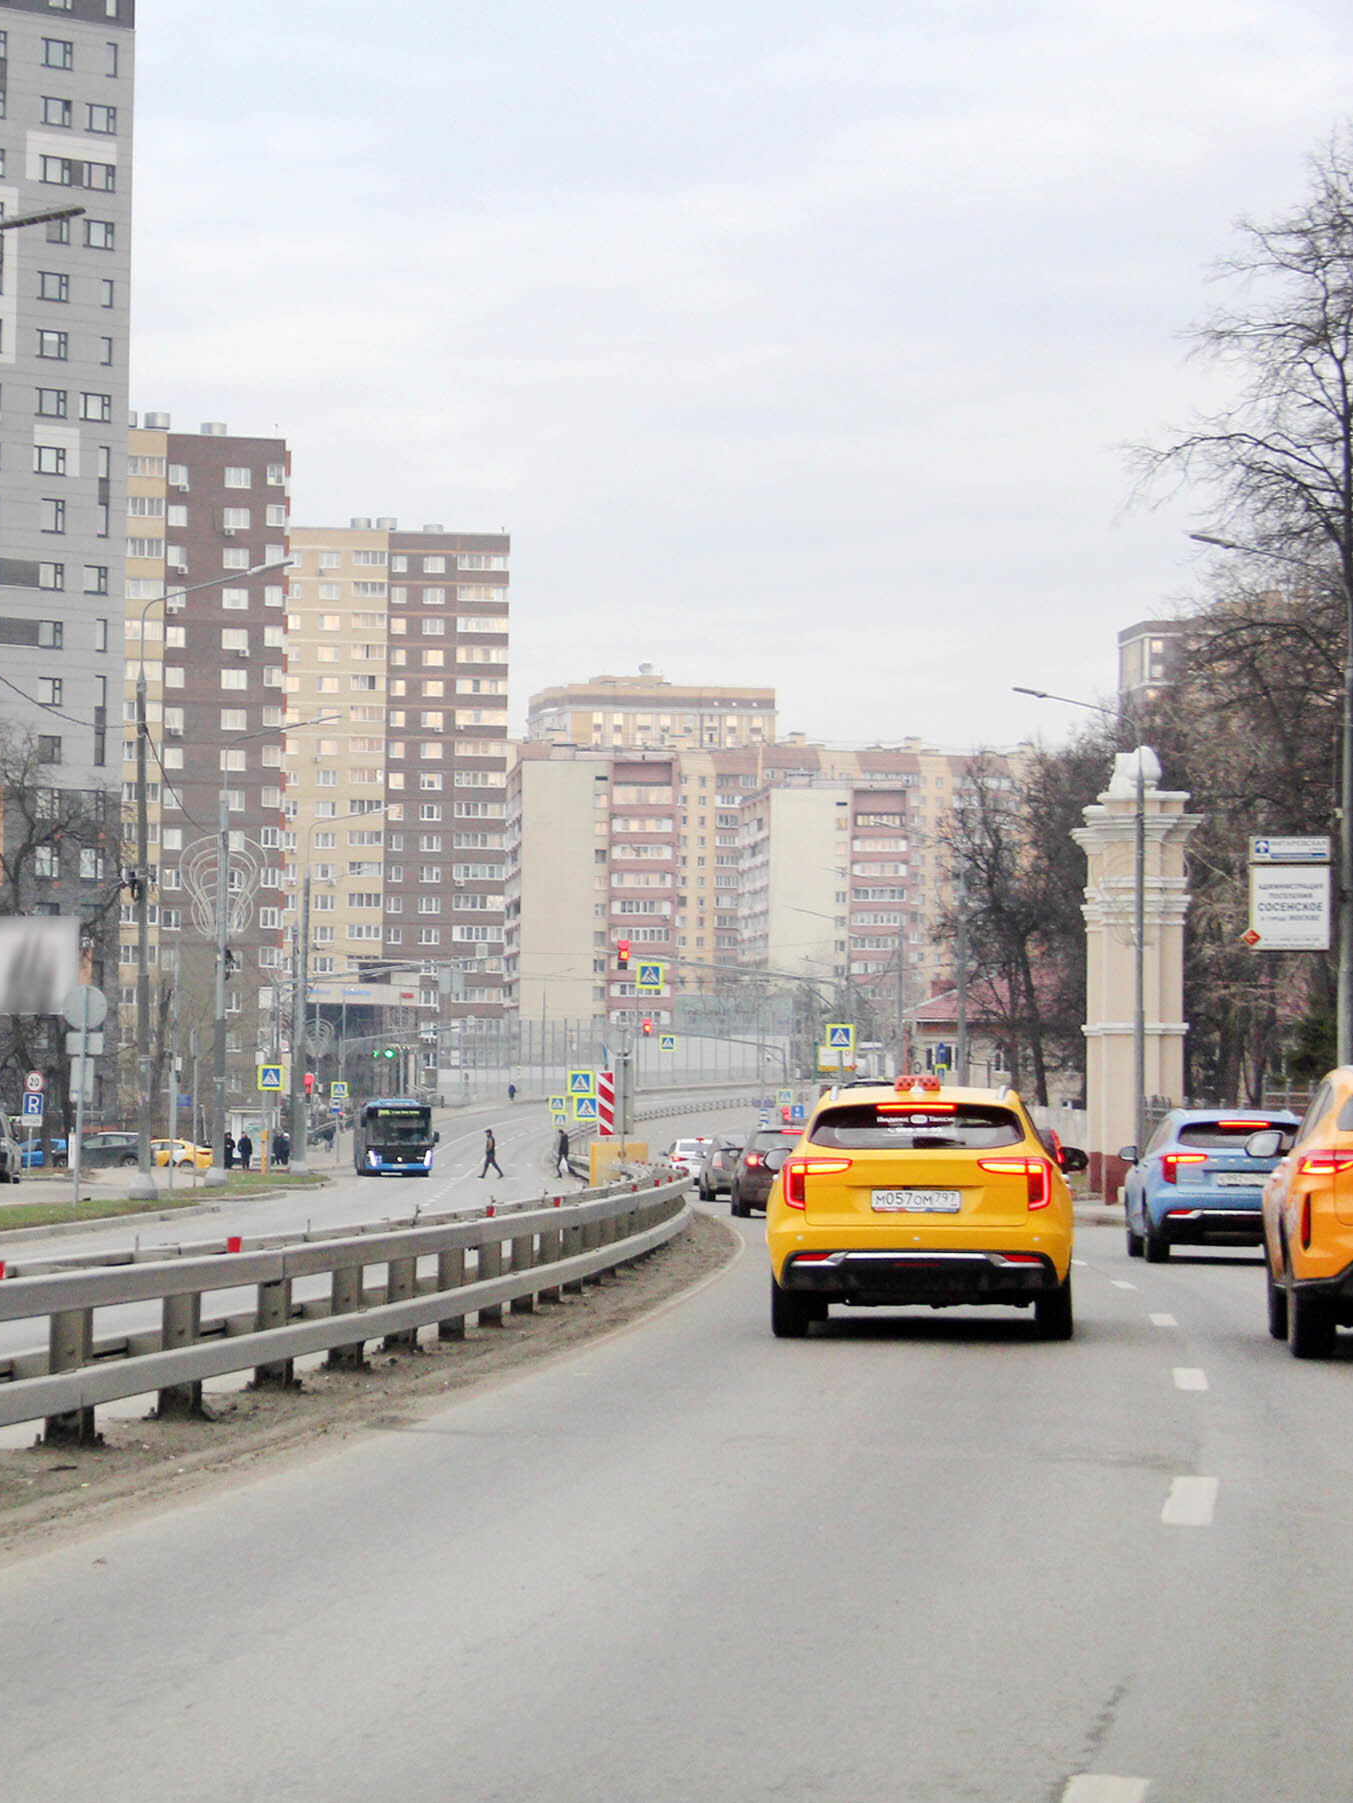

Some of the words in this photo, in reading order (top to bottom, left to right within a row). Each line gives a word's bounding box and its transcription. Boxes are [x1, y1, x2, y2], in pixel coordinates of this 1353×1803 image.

[1257, 902, 1324, 912] СОСЕНСКОЕ
[29, 1076, 40, 1087] 20
[875, 1192, 933, 1206] М057ОМ
[935, 1191, 957, 1202] 797
